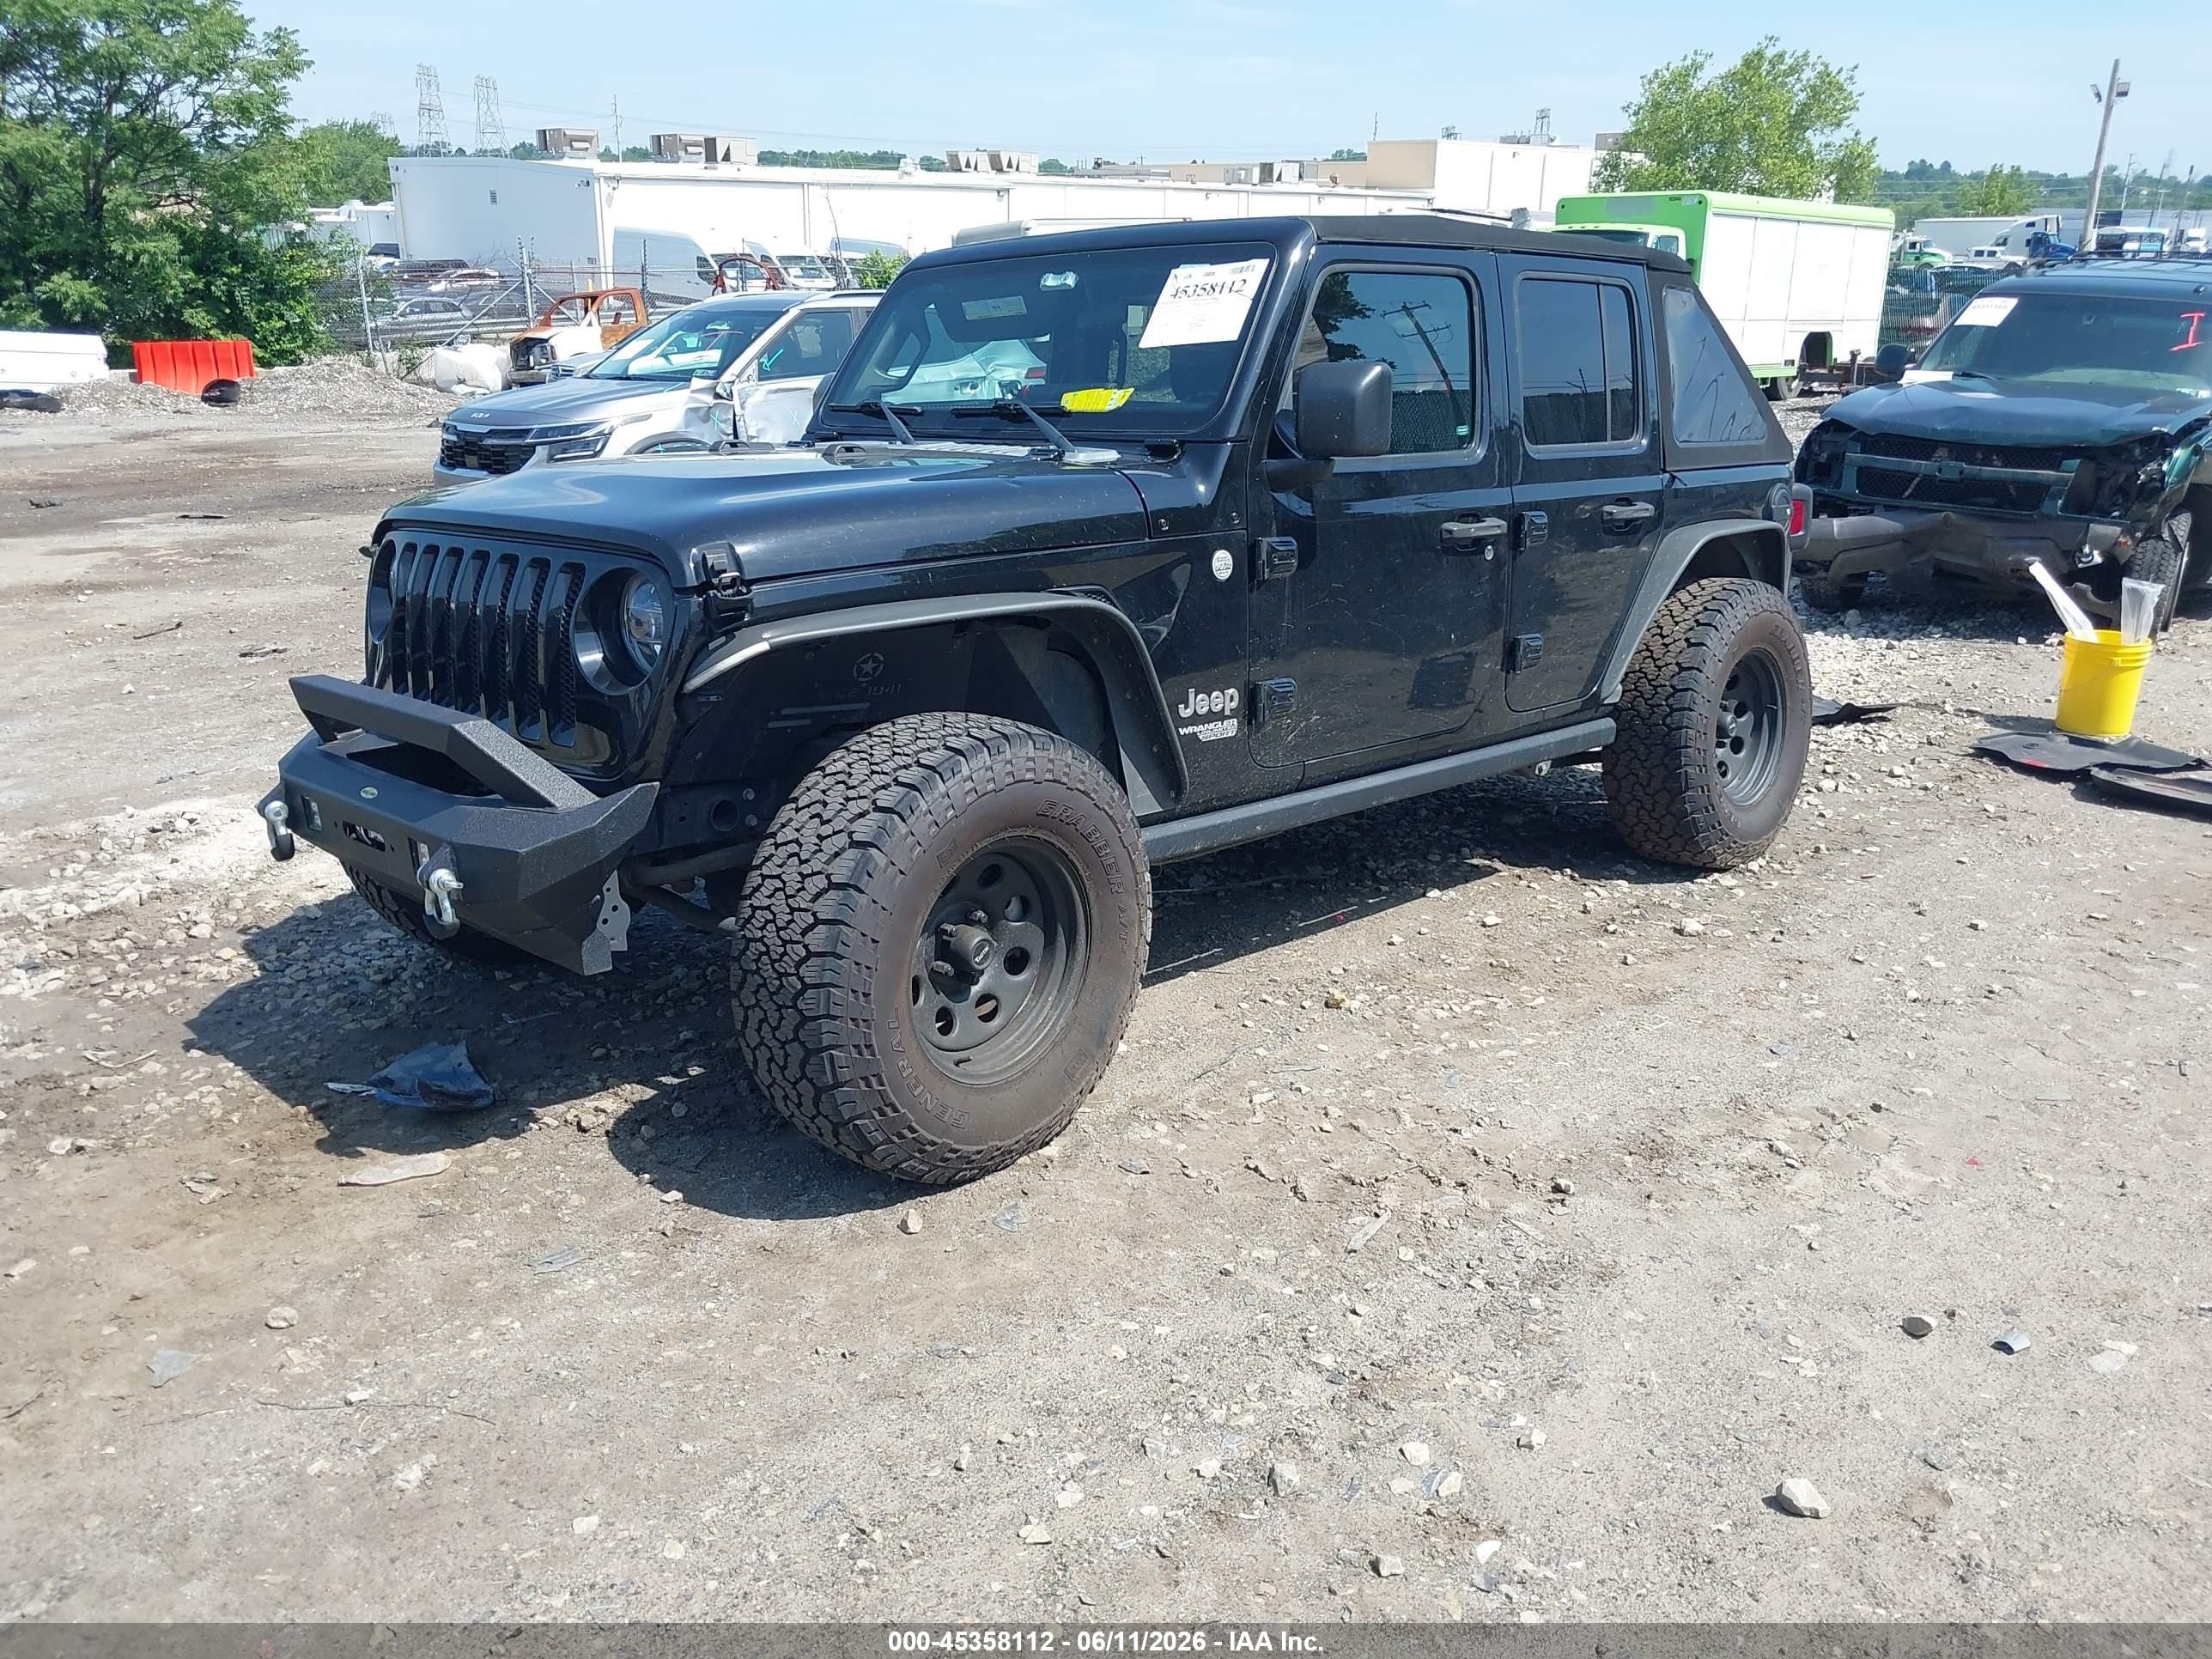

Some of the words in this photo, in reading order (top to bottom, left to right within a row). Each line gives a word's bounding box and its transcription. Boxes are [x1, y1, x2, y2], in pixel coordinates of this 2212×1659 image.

[1170, 278, 1248, 300] 45358112
[1178, 688, 1239, 718] Jeep
[1178, 718, 1237, 736] WRANGLER
[1036, 799, 1125, 895] GRABBER
[887, 1006, 971, 1130] GENERAL
